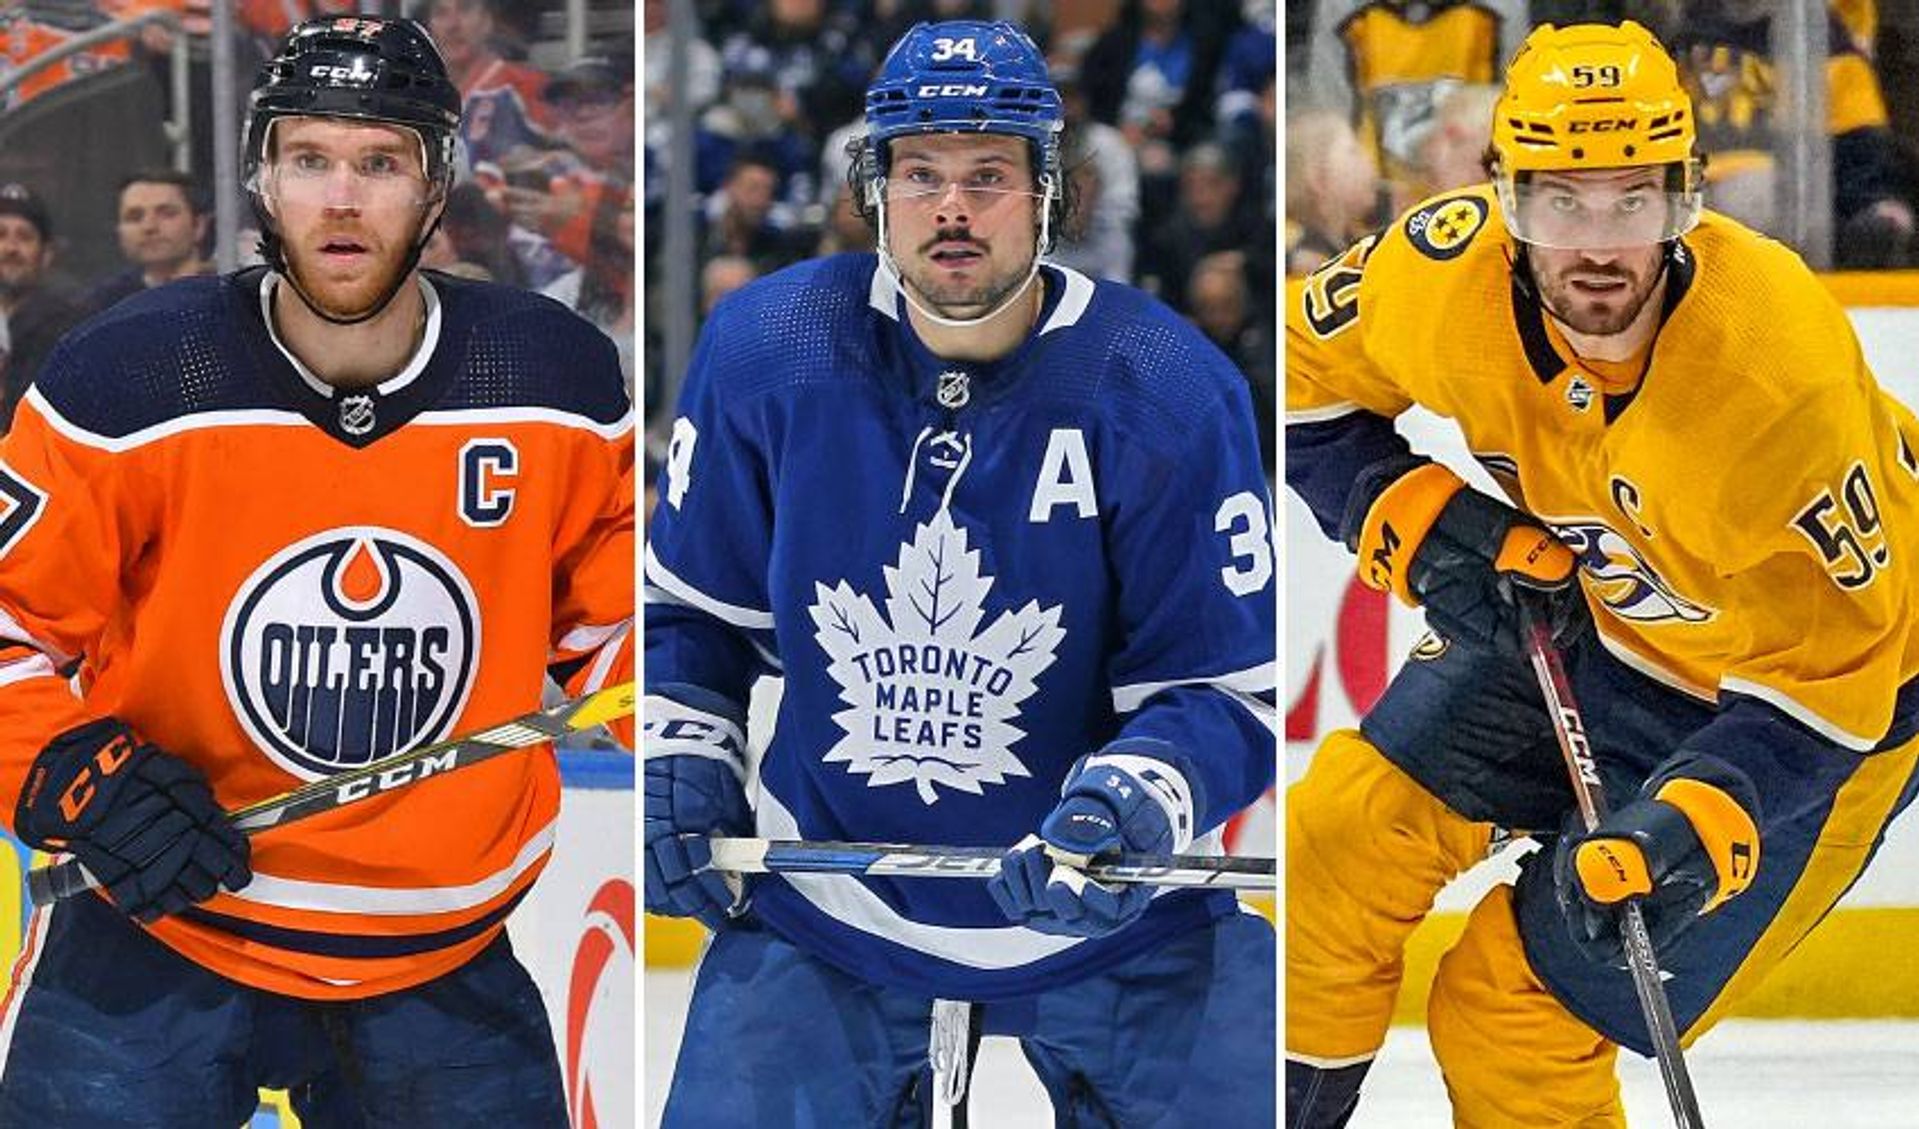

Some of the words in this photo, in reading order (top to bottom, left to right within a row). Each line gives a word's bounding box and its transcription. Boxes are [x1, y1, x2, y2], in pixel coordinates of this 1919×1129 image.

[932, 38, 976, 62] 34
[1573, 65, 1620, 89] 59
[918, 85, 988, 97] CCM
[1569, 119, 1638, 135] CCM
[457, 438, 518, 527] C
[1030, 429, 1098, 522] A
[1610, 474, 1656, 540] C
[1788, 458, 1890, 592] 59
[1215, 490, 1276, 597] 3
[260, 623, 448, 764] OILERS
[851, 644, 1013, 696] TORONTO
[876, 682, 983, 718] MAPLE
[874, 715, 982, 749] LEAFS
[1561, 706, 1602, 786] CCM
[60, 734, 138, 822] CC
[337, 750, 456, 804] CCM
